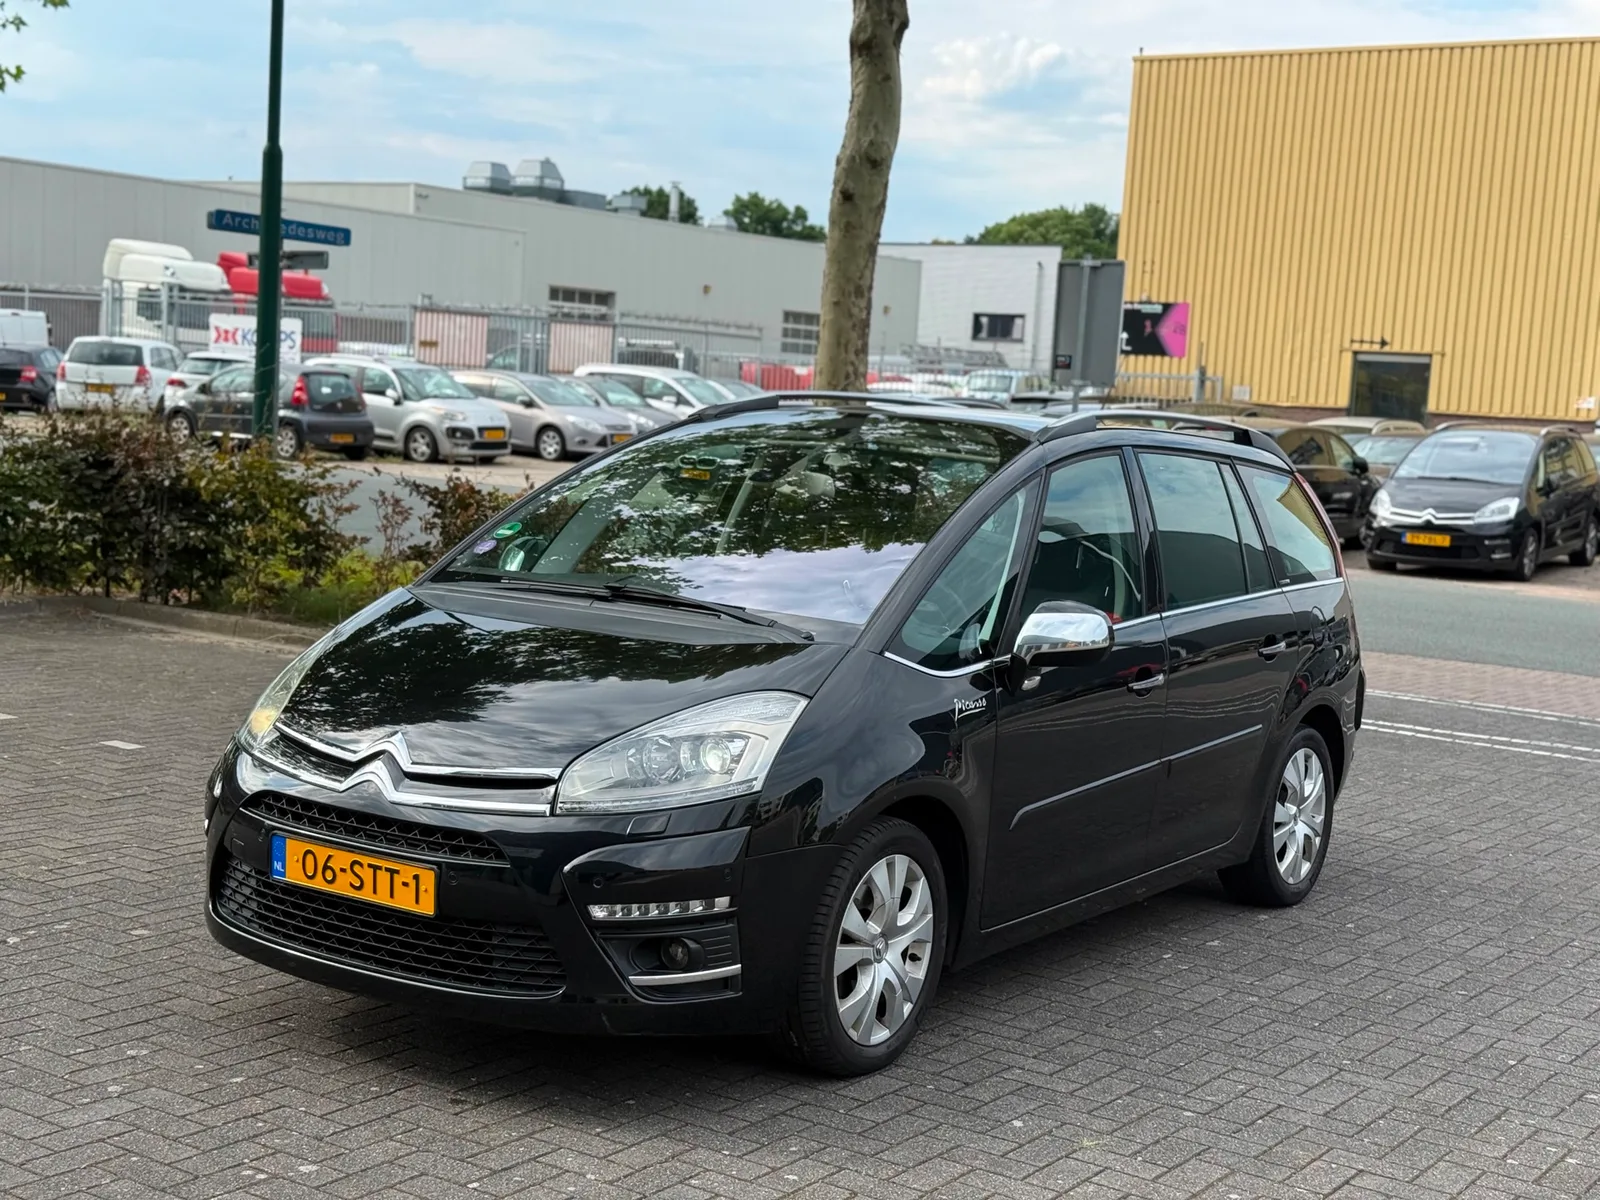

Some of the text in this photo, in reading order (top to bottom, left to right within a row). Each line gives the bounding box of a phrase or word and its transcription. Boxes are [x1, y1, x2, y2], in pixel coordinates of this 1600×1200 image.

[222, 212, 345, 244] Archedesweg
[241, 328, 297, 350] KOPS
[273, 860, 285, 872] NL
[301, 848, 421, 906] 06-STT-1
